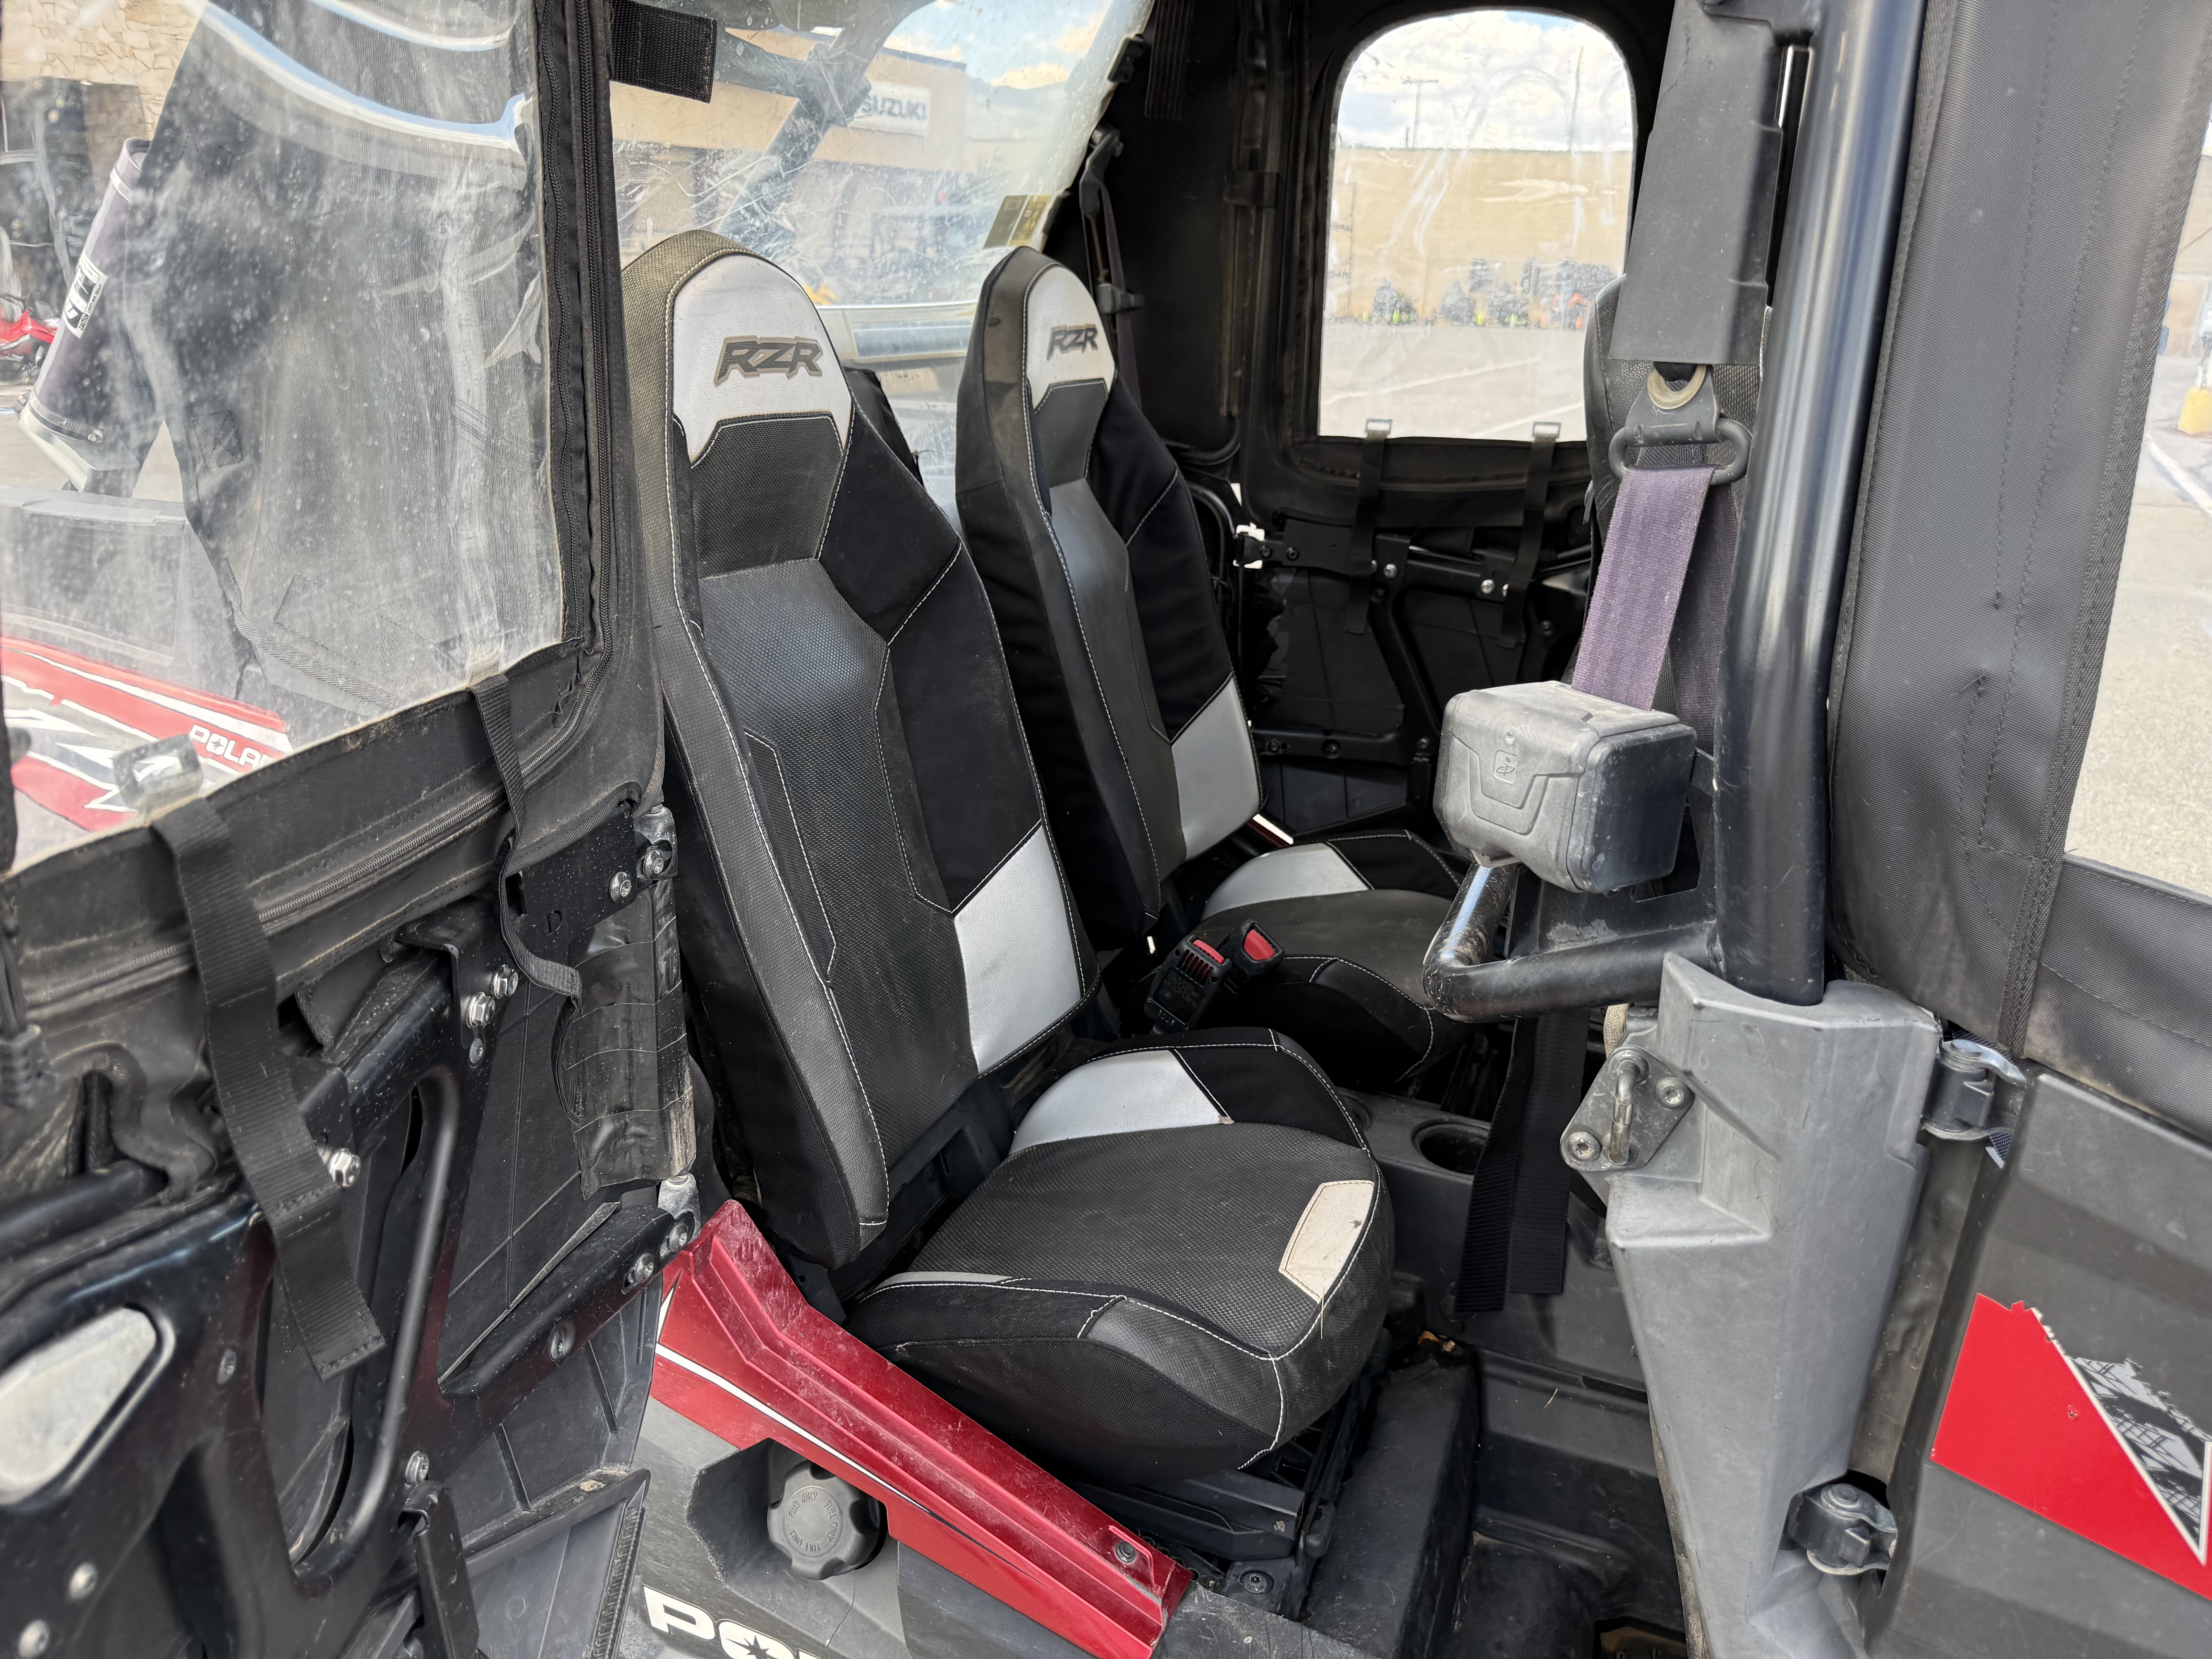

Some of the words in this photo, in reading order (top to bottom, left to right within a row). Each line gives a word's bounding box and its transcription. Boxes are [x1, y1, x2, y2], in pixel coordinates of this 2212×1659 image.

[1047, 324, 1098, 362] RZR
[714, 336, 823, 387] RZR
[789, 1501, 800, 1517] FUEL
[802, 1492, 817, 1503] ONLY
[824, 1501, 836, 1519] FUEL
[827, 1522, 837, 1541] ONLY
[643, 1585, 820, 1659] PO
